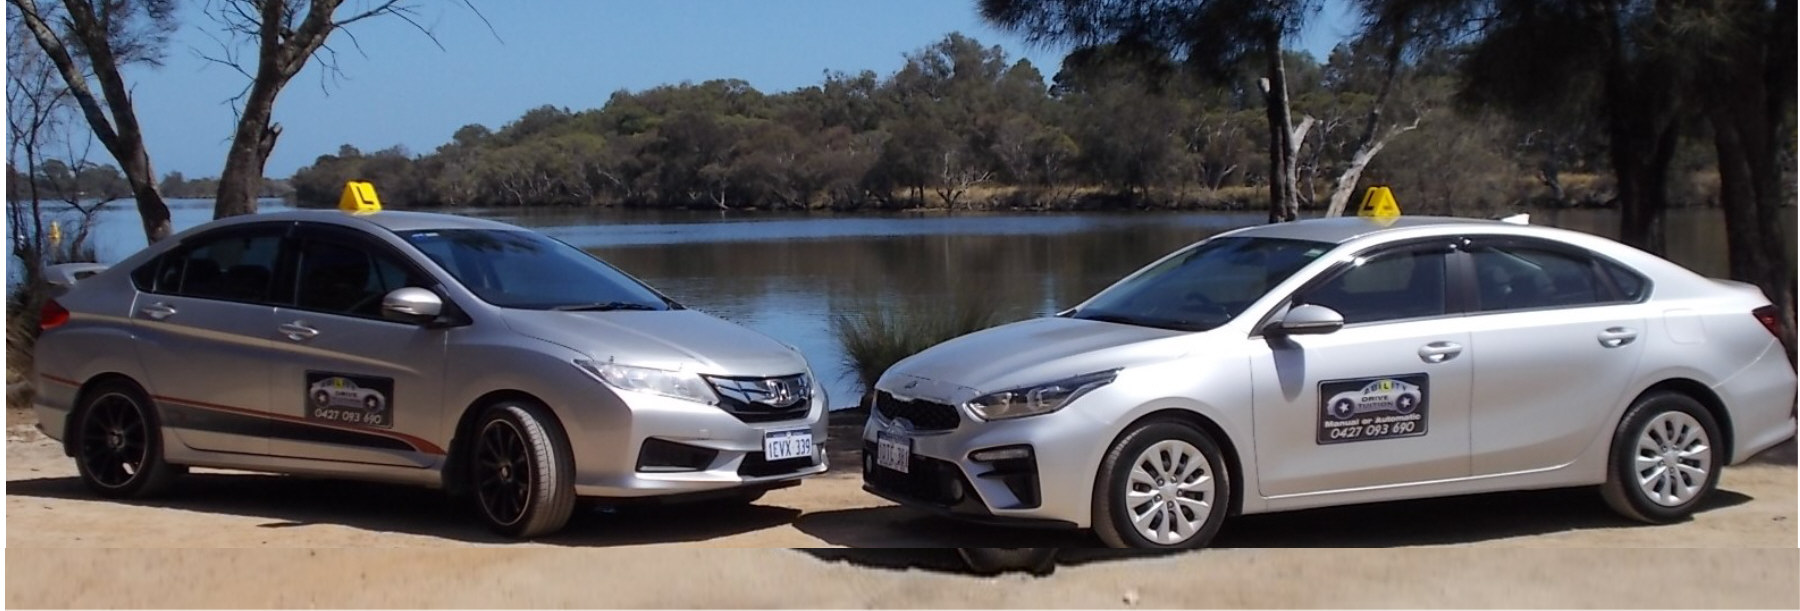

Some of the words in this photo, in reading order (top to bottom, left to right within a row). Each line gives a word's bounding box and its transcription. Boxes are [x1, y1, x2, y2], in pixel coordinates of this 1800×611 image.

[356, 186, 375, 205] L
[1363, 190, 1375, 211] L
[1363, 381, 1407, 395] ABILITY
[1358, 401, 1394, 410] TUITION
[1361, 395, 1389, 403] DRIVE
[314, 408, 340, 420] 0427
[342, 411, 361, 422] 093
[363, 413, 382, 424] 690
[1324, 420, 1360, 428] Manual
[1374, 413, 1421, 423] Automatic
[1330, 426, 1363, 439] 0427
[1365, 423, 1389, 437] 093
[1392, 421, 1415, 434] 690
[769, 440, 792, 458] 1EVX
[795, 438, 810, 456] 339
